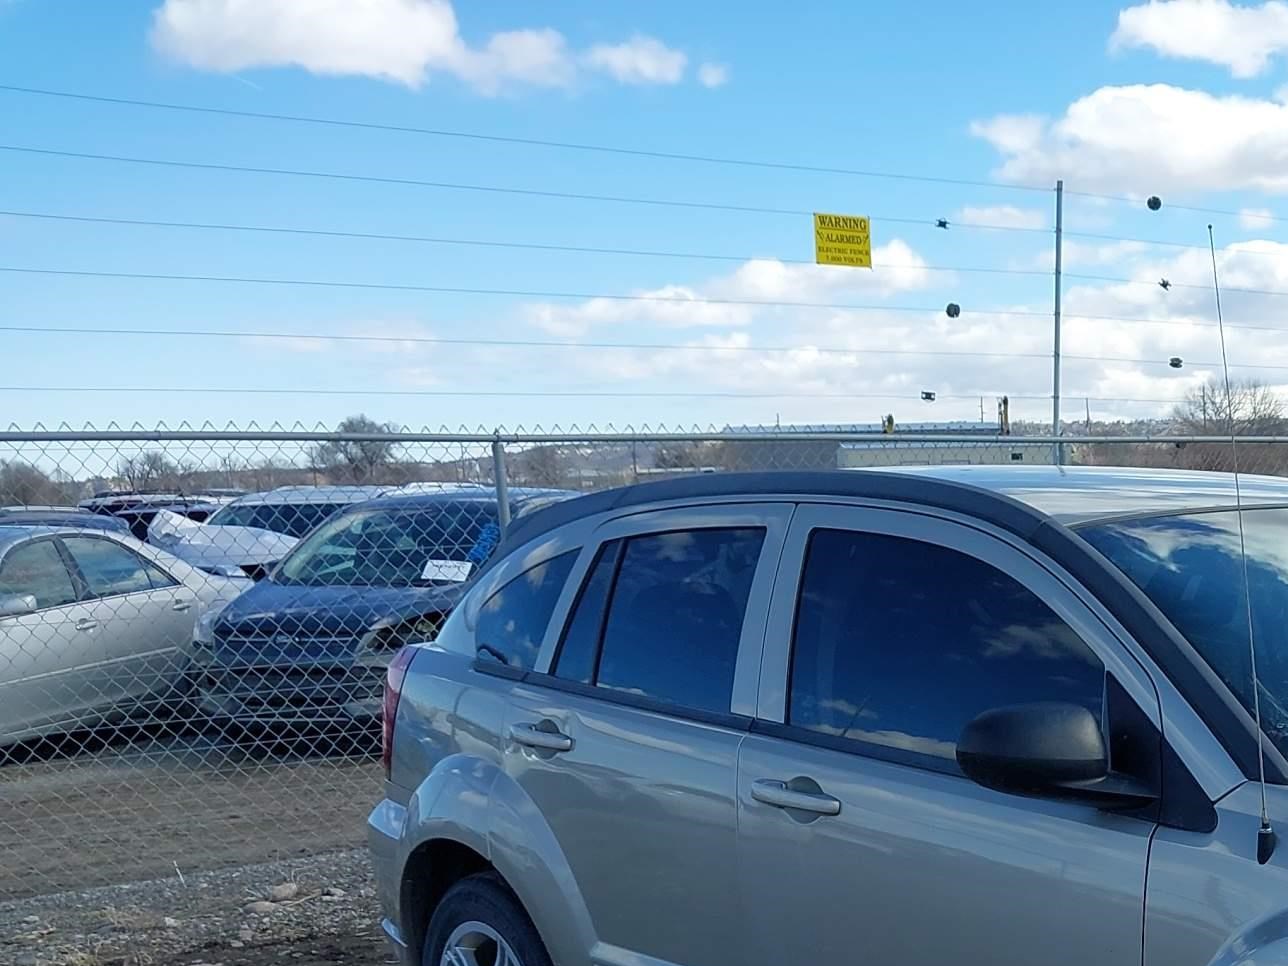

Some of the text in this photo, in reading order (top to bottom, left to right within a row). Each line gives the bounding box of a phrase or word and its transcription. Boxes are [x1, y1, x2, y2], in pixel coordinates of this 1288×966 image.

[818, 215, 867, 230] WARNING
[825, 233, 862, 245] ALARMED
[818, 246, 848, 255] ELECTRIC
